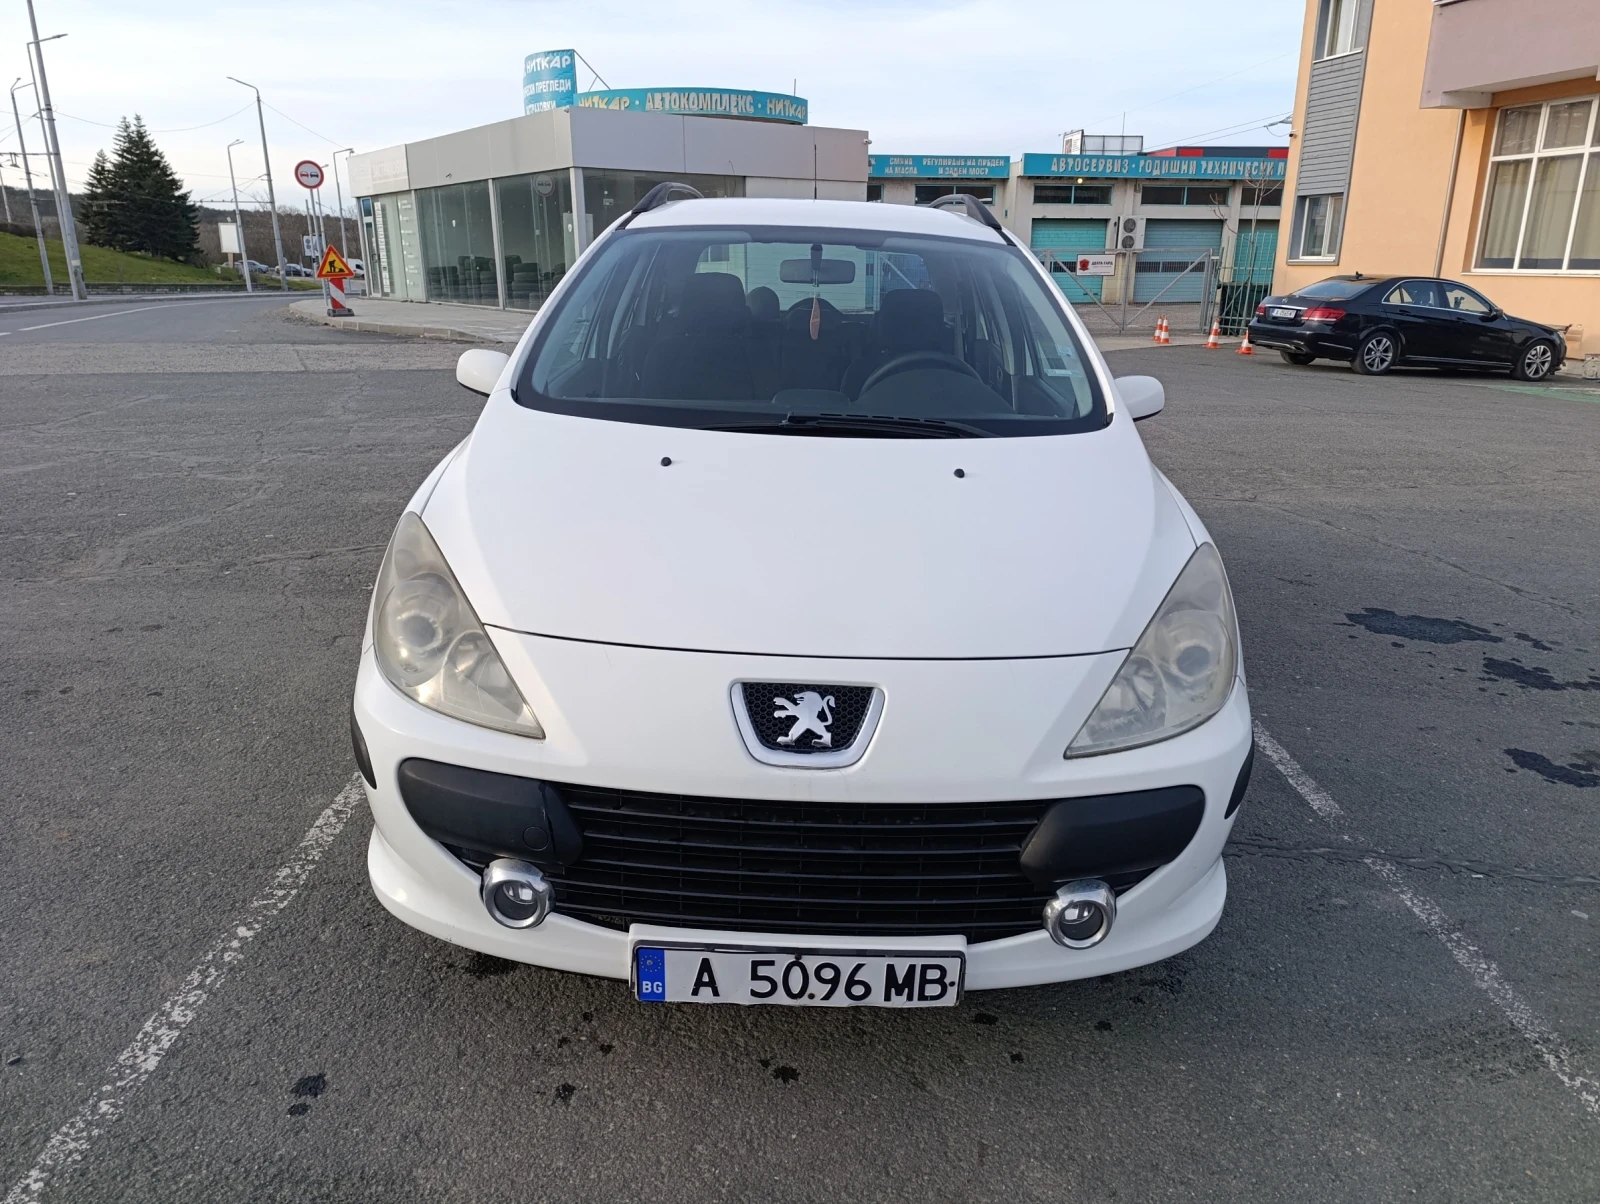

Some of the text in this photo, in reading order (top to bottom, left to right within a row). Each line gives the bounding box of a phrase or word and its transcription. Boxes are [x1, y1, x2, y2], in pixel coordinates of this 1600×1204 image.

[526, 55, 571, 74] НИТКАР
[535, 78, 572, 93] ПРЕГЛЕДИ
[578, 91, 806, 119] НИТКАР АВТОКОМПЛЕКС НИТКАР
[889, 157, 913, 165] СМЯНА
[966, 158, 976, 166] НА
[977, 158, 1005, 167] ПРЕДЕН
[1051, 157, 1129, 173] АВТОСЕРВИЗ
[1138, 159, 1197, 176] ГОДИШНИ
[1200, 160, 1274, 176] ТЕХНИЧЕСКИ
[885, 166, 894, 174] НА
[945, 167, 967, 175] ЗАДЕН
[968, 167, 989, 175] МОСТ
[691, 957, 949, 1002] A 5096 MB
[642, 981, 663, 994] BG
